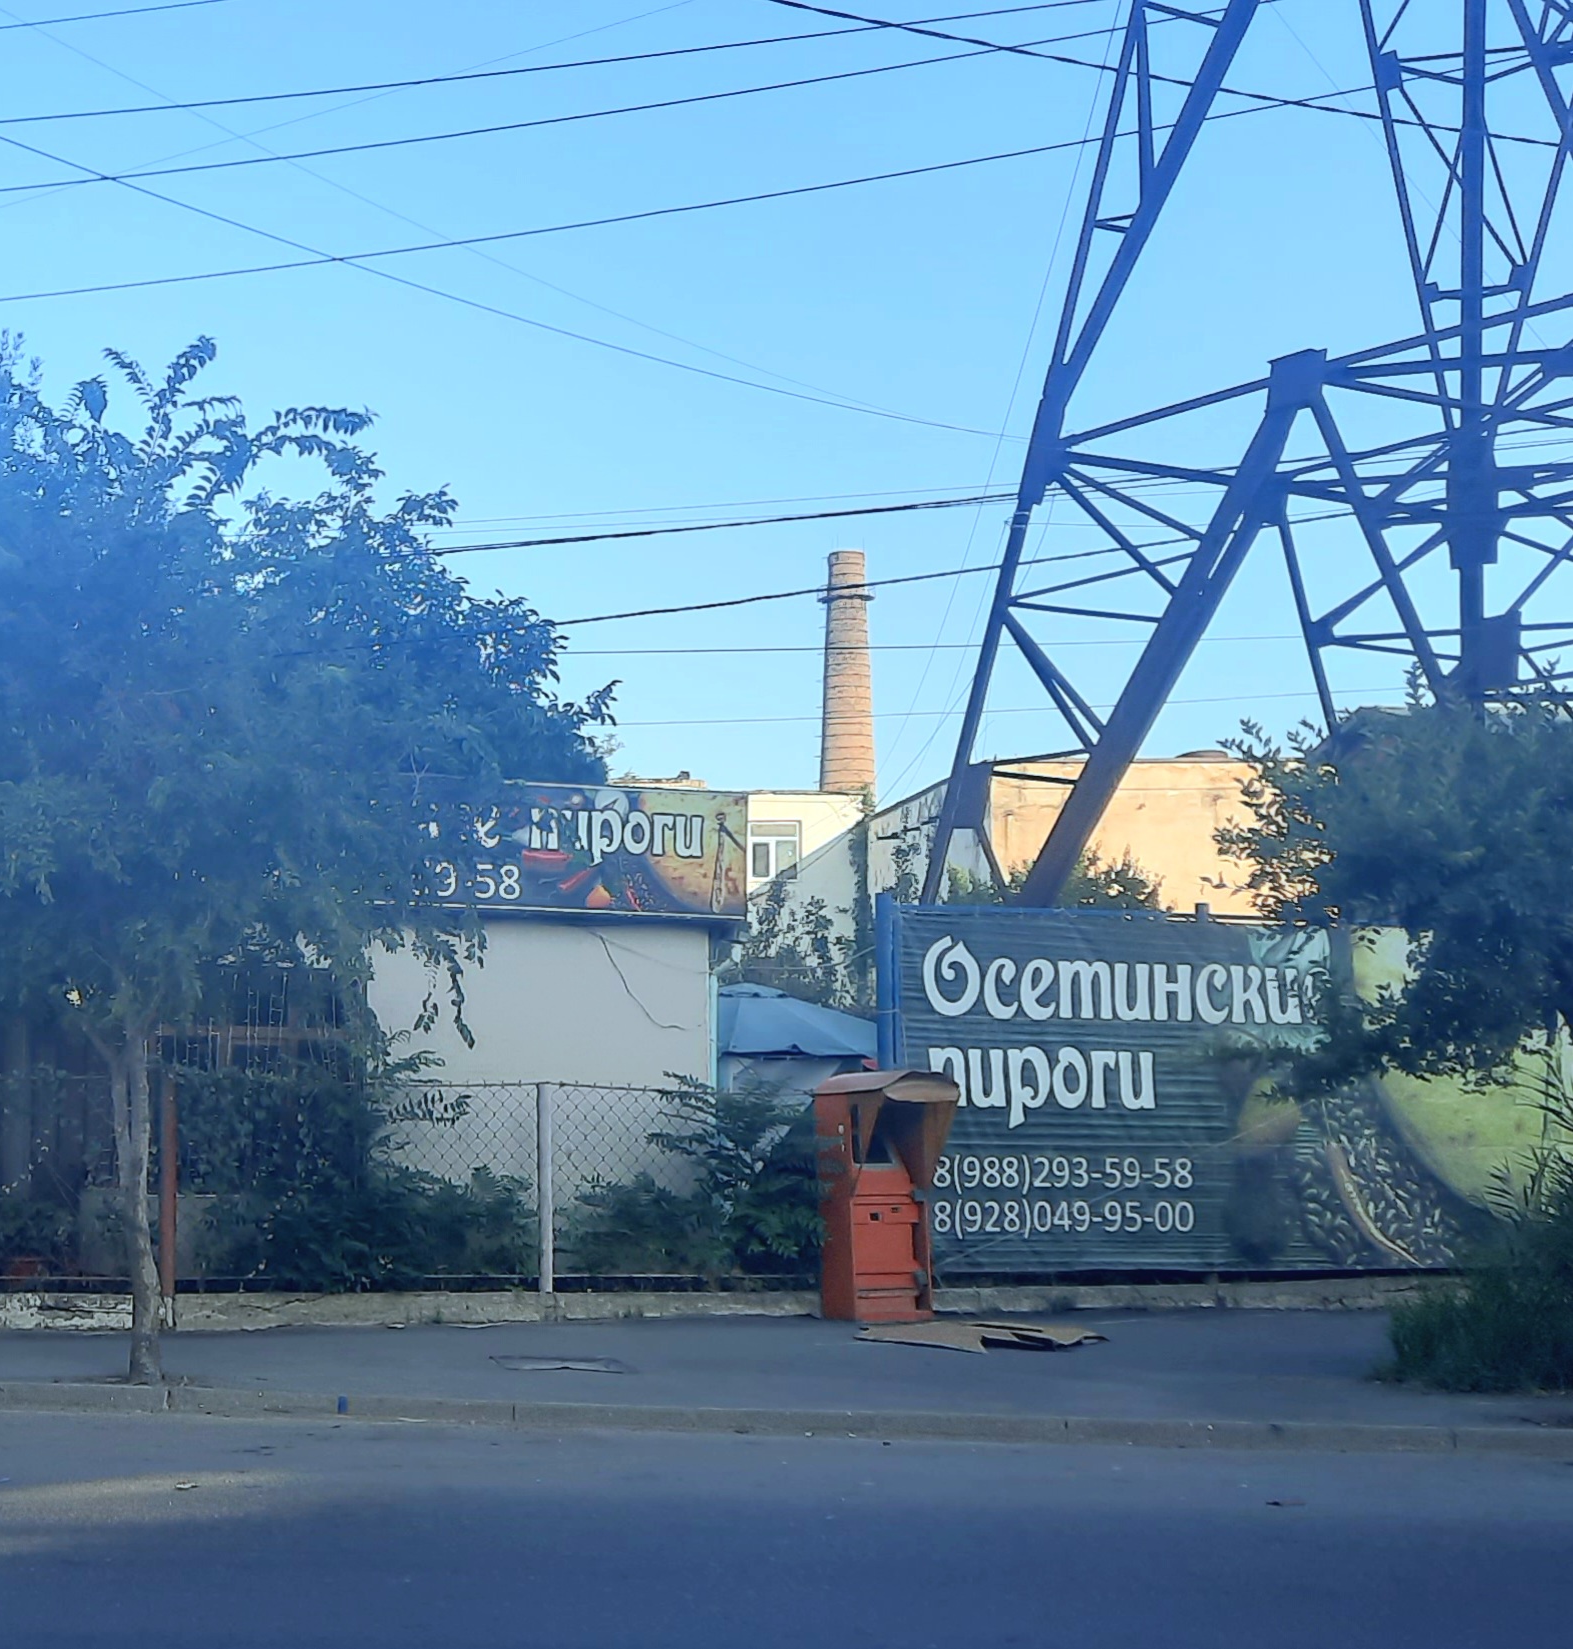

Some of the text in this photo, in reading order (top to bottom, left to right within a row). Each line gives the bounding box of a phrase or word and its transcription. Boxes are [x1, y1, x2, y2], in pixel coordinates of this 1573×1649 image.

[929, 1045, 1156, 1130] пироги
[932, 1154, 1194, 1195] 8(988)293-59-58
[933, 1198, 1196, 1240] 8(928)049-95-00
